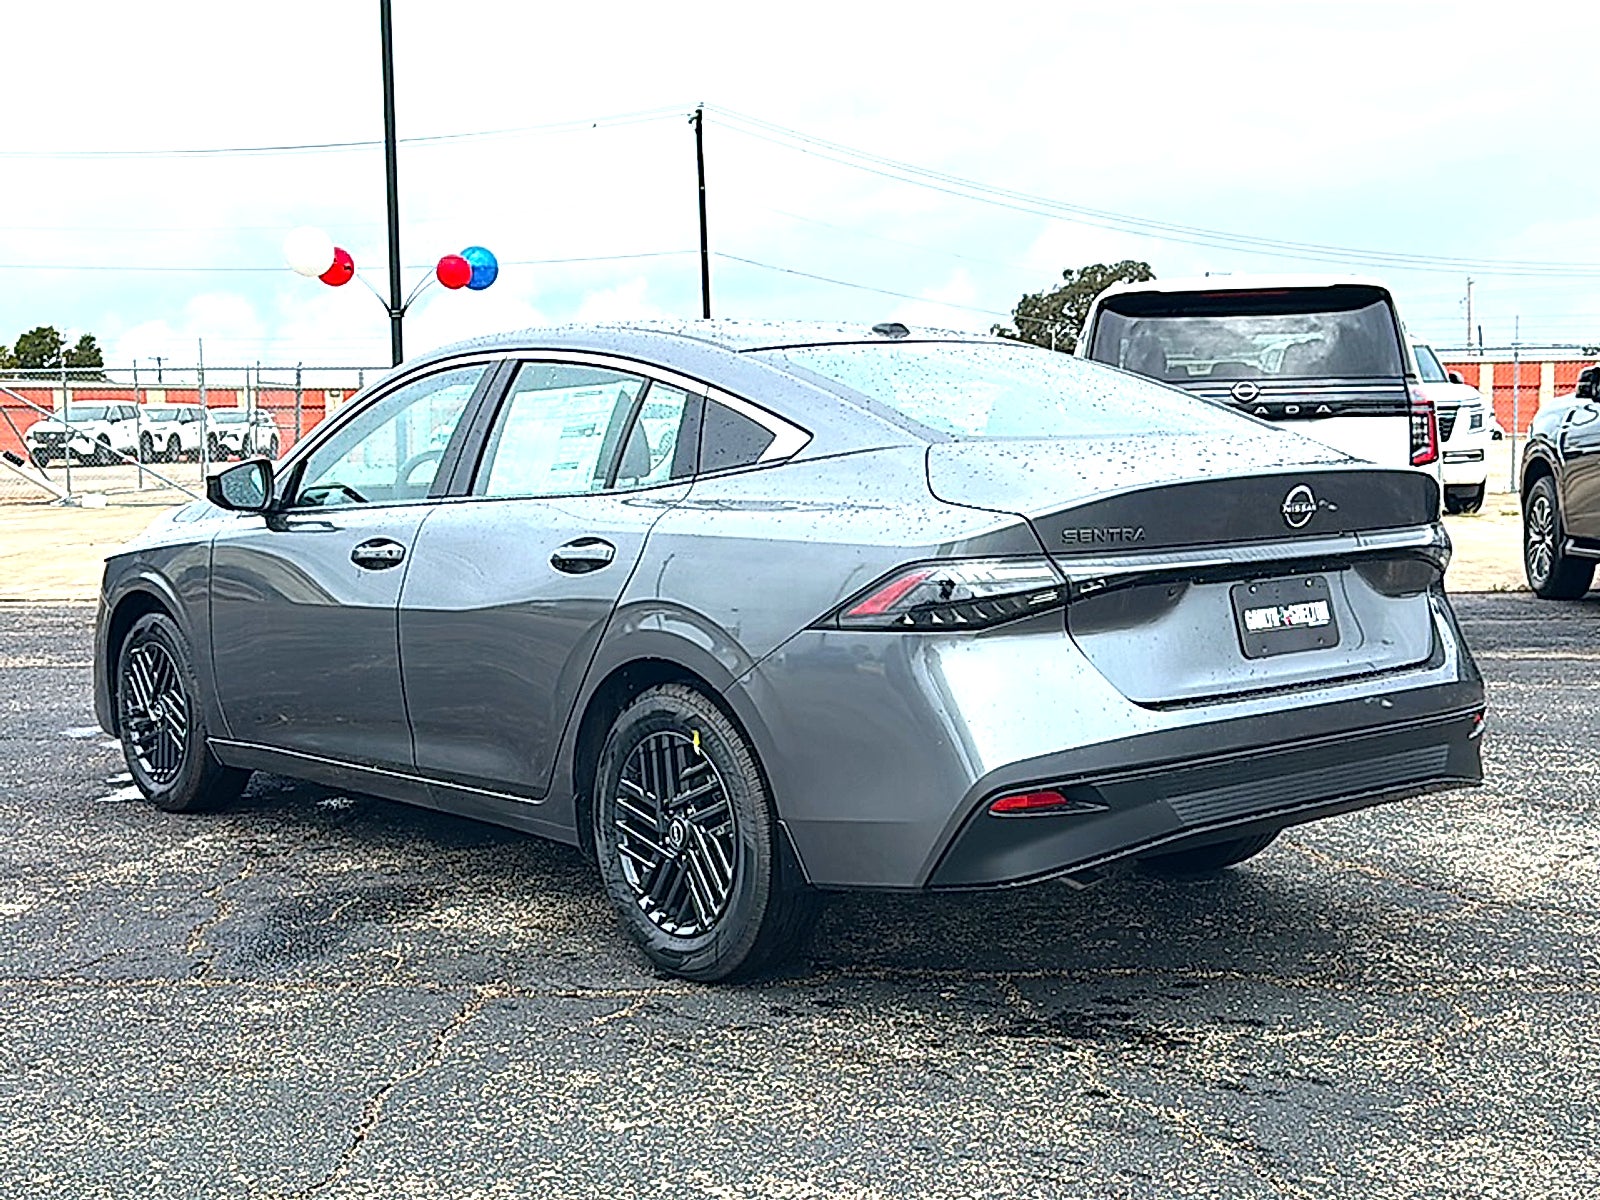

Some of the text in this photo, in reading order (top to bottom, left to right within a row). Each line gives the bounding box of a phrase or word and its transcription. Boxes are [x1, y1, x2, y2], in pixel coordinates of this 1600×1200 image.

[1254, 404, 1332, 415] ADA
[1282, 501, 1317, 513] NISSAN
[1062, 526, 1146, 543] SENTRA
